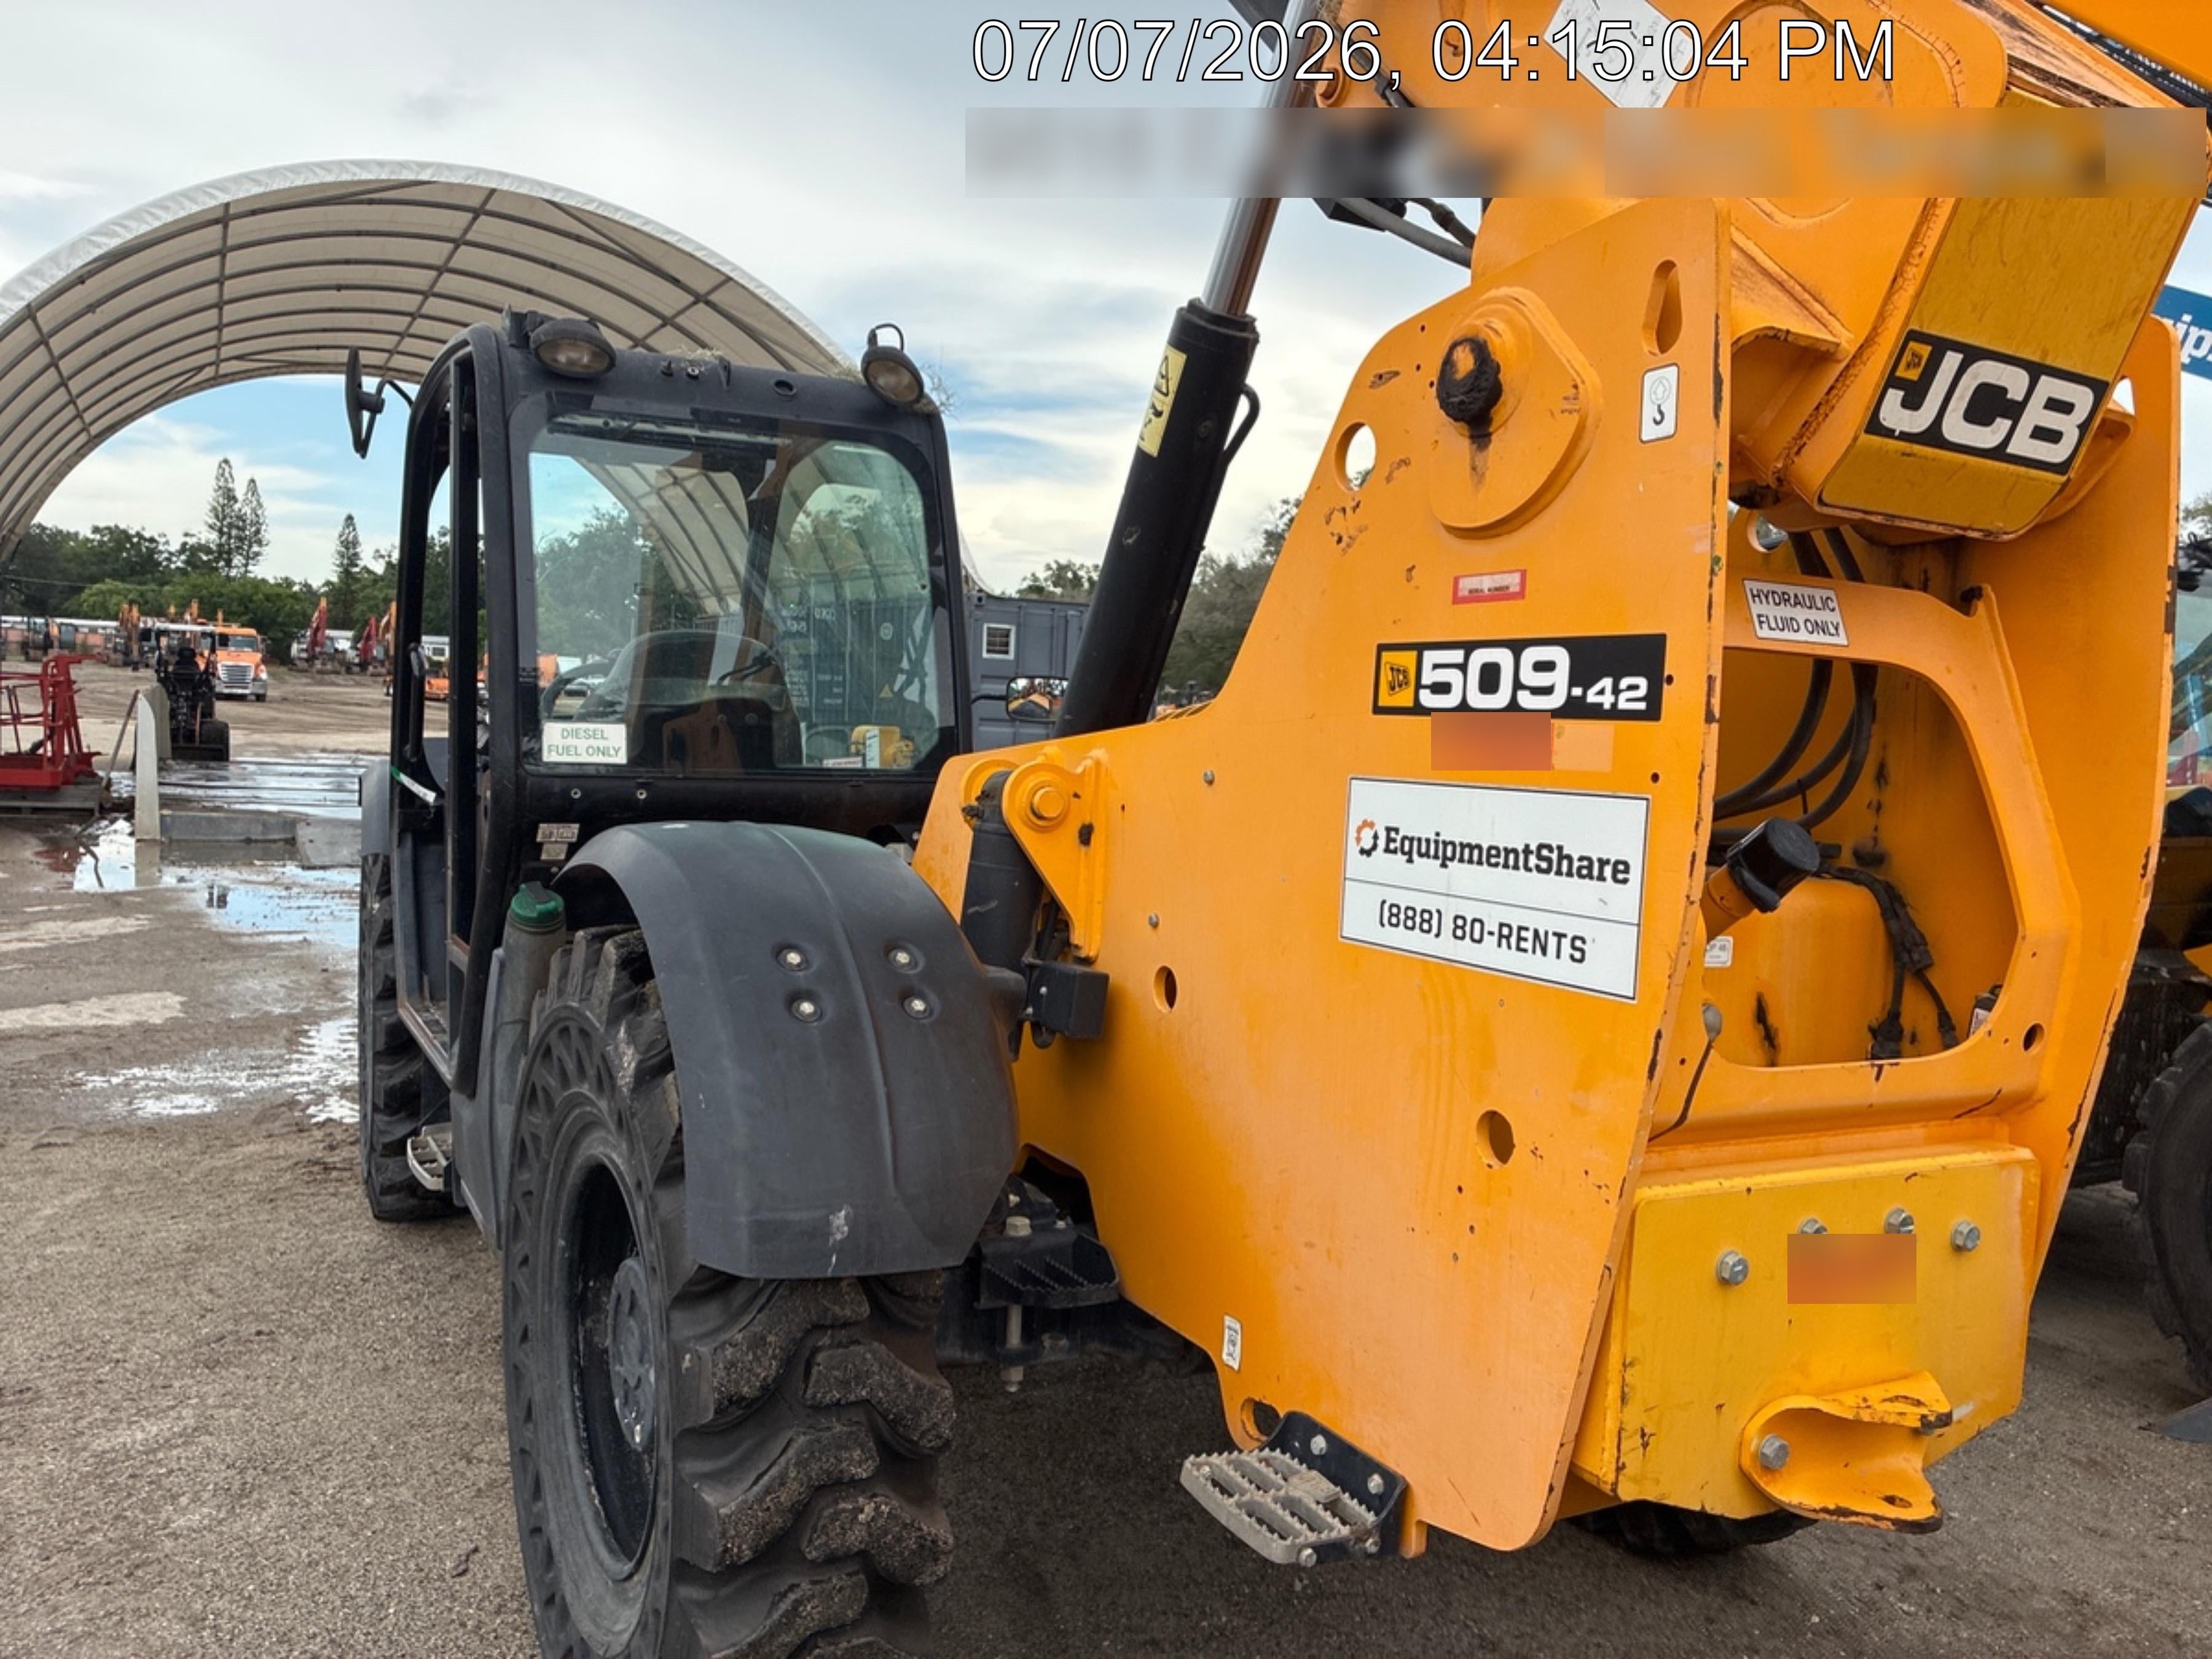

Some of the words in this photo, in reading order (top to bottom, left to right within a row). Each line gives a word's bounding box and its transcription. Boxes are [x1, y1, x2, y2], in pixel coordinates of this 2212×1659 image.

[1879, 350, 2095, 464] JCB
[1749, 588, 1836, 612] HYDRAULIC
[1756, 614, 1800, 633] FLUID
[1805, 619, 1840, 637] ONLY
[1388, 665, 1410, 692] JCB
[1419, 645, 1649, 710] 509-42
[561, 728, 608, 740] DIESEL
[547, 745, 581, 756] FUEL
[586, 745, 621, 757] ONLY
[1384, 825, 1630, 885] EquipmentShare
[1379, 899, 1442, 938] (888)
[1451, 915, 1587, 964] 80-RENTS
